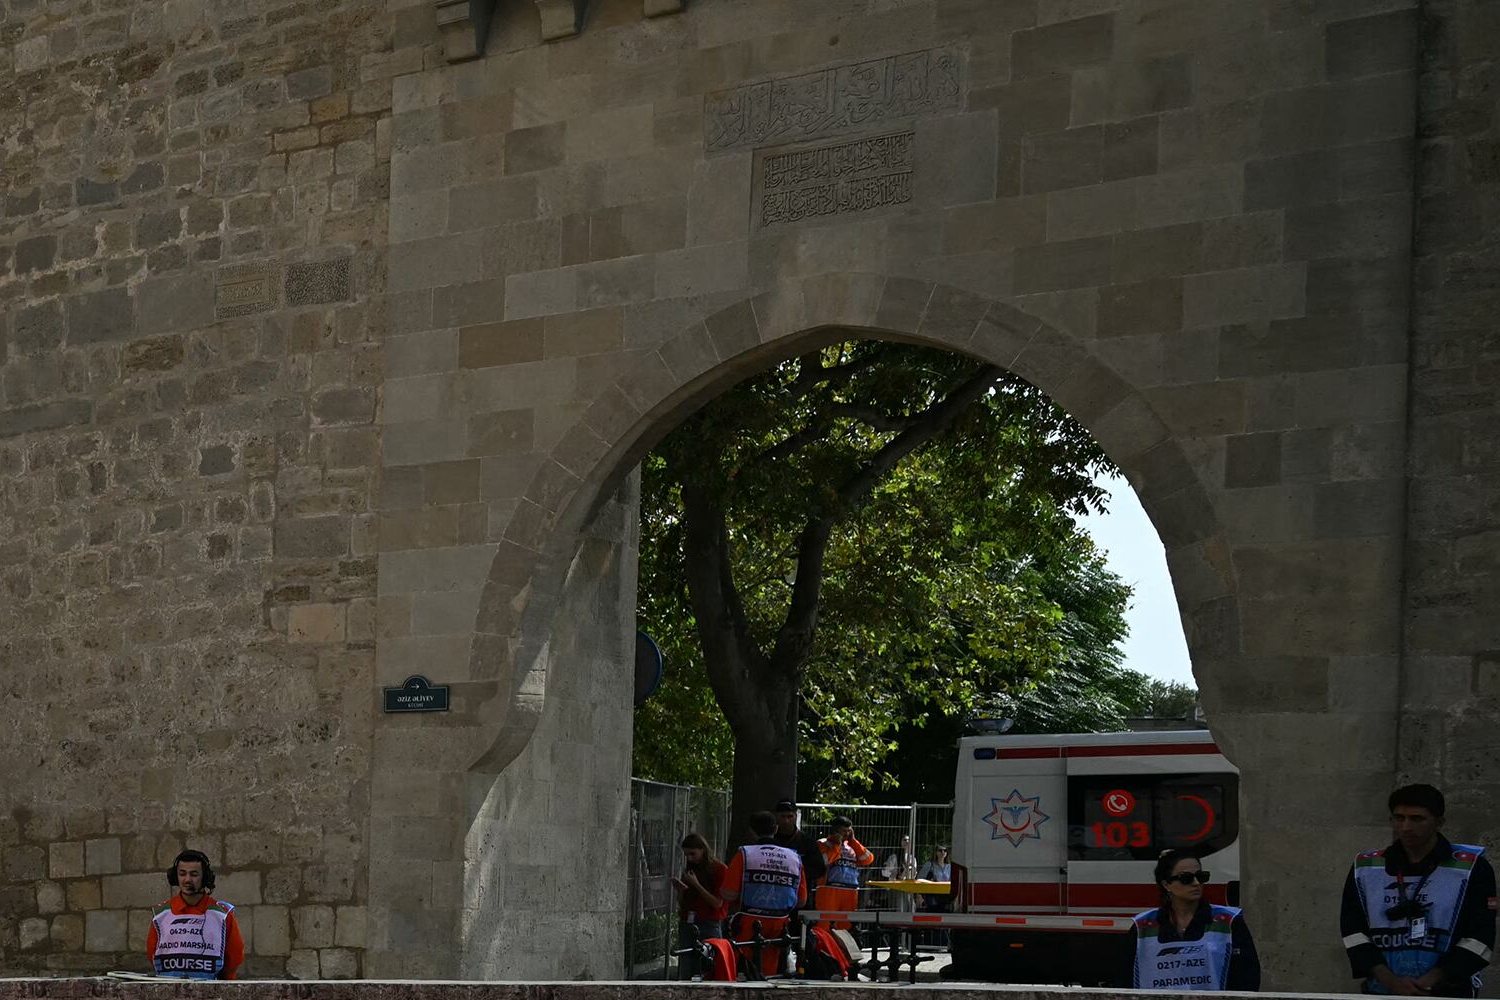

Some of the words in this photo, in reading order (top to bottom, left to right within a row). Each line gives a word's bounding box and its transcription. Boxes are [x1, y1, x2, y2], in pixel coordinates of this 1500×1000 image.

[1091, 821, 1149, 848] 103
[753, 872, 794, 886] COURSE
[164, 957, 213, 971] COURSE
[1156, 958, 1205, 970] 0217-AZE
[1153, 975, 1212, 988] PARAMEDIC
